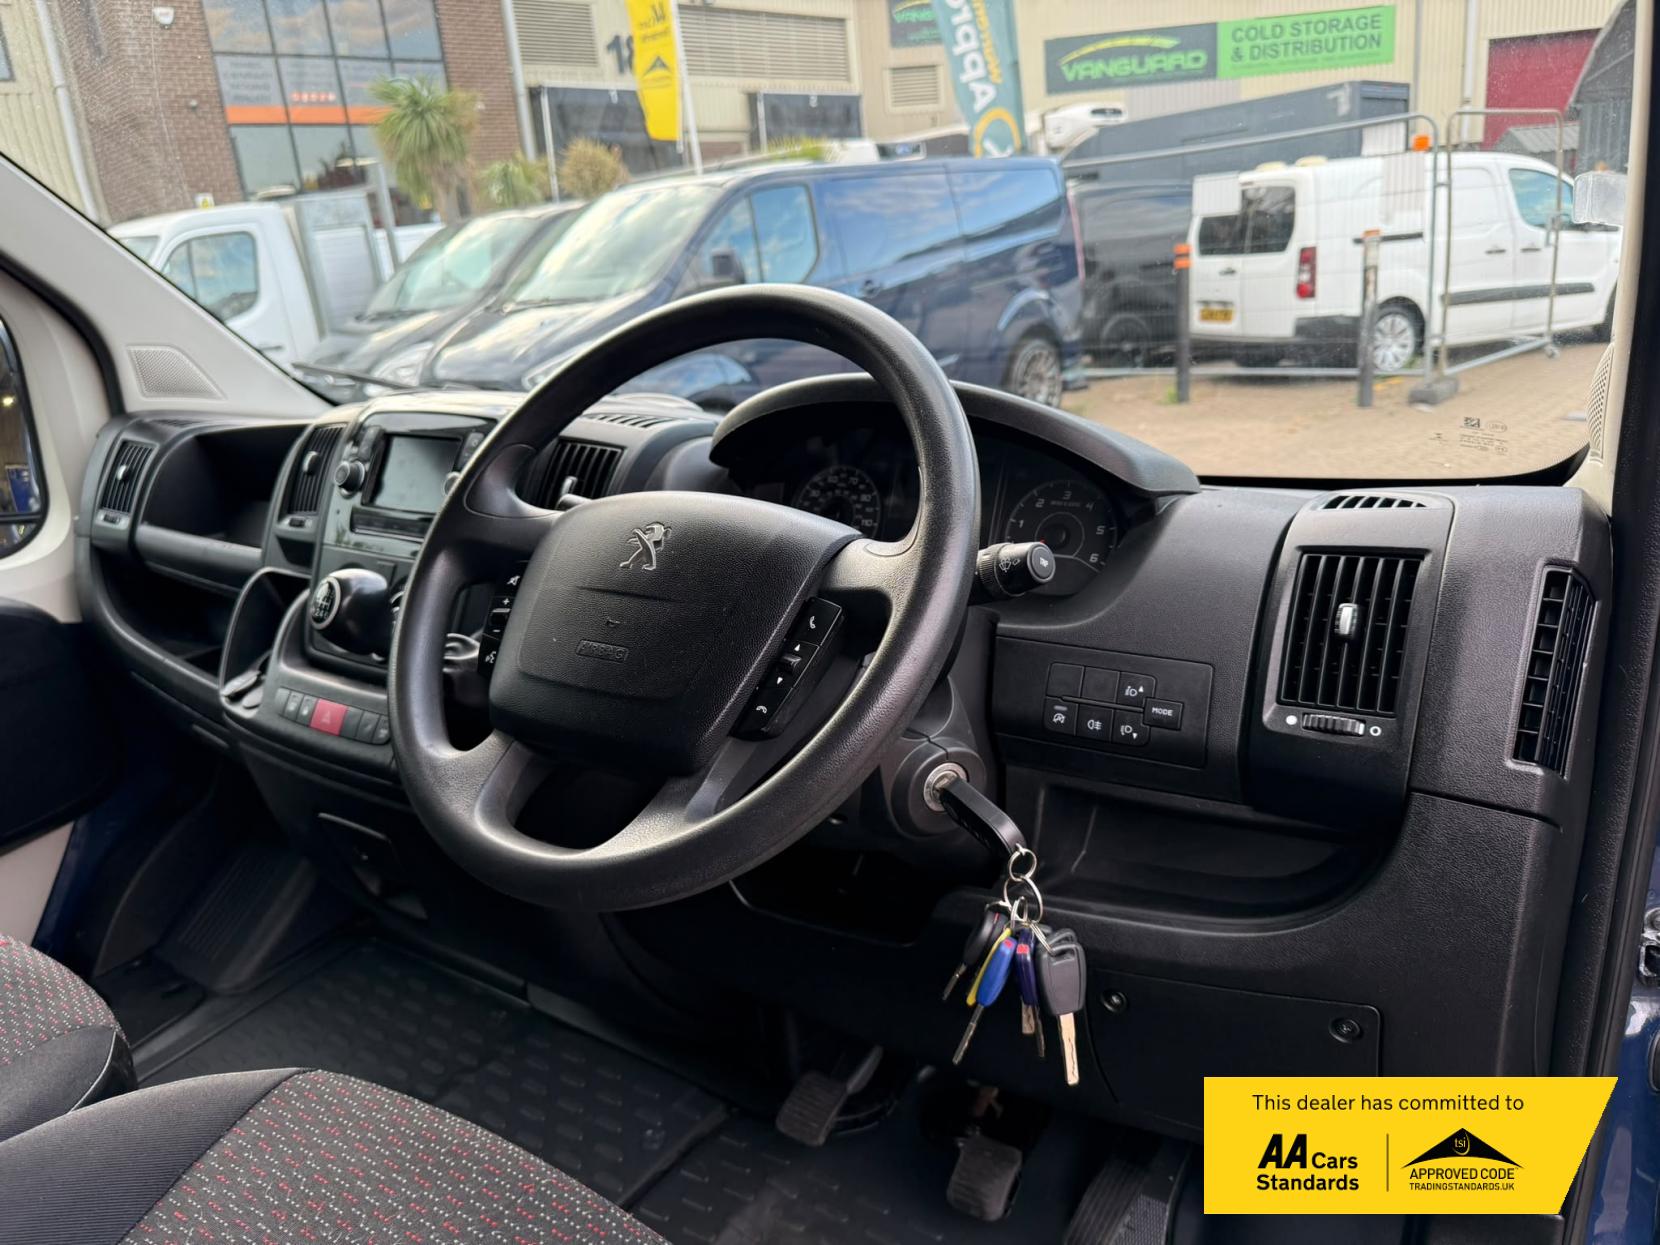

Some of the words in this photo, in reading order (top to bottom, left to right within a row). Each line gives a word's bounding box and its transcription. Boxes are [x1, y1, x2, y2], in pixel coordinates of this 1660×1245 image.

[1231, 24, 1284, 43] COLD
[1290, 14, 1382, 38] STORAGE
[1230, 47, 1243, 62] &
[1250, 33, 1382, 61] DISTRIBUTION
[1060, 51, 1209, 82] VANGUARD
[1062, 491, 1073, 500] 3
[1035, 498, 1045, 508] 2
[1017, 519, 1024, 529] 1
[1096, 525, 1106, 535] 5
[1089, 553, 1099, 563] 6
[1151, 706, 1173, 717] MODE
